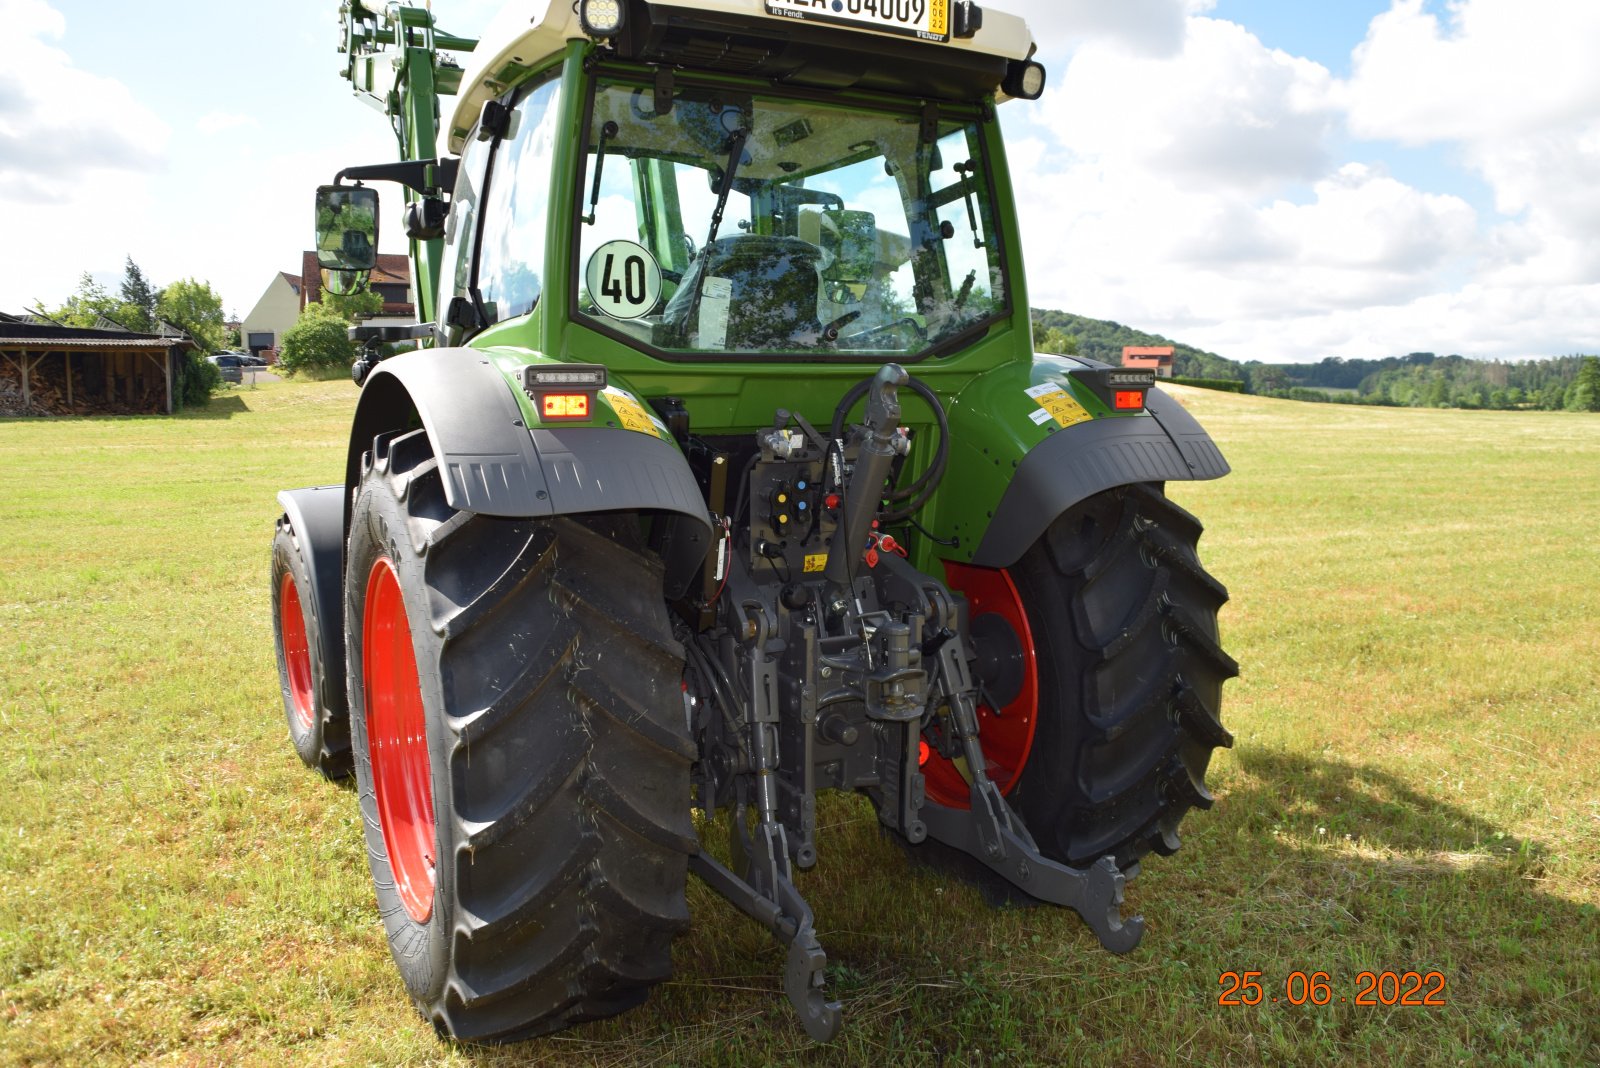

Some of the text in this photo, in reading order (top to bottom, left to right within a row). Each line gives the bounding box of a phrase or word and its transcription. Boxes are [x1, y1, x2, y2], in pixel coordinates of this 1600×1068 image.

[932, 8, 943, 17] 06
[932, 19, 943, 29] 22
[916, 31, 945, 42] FENDT
[601, 253, 646, 305] 40
